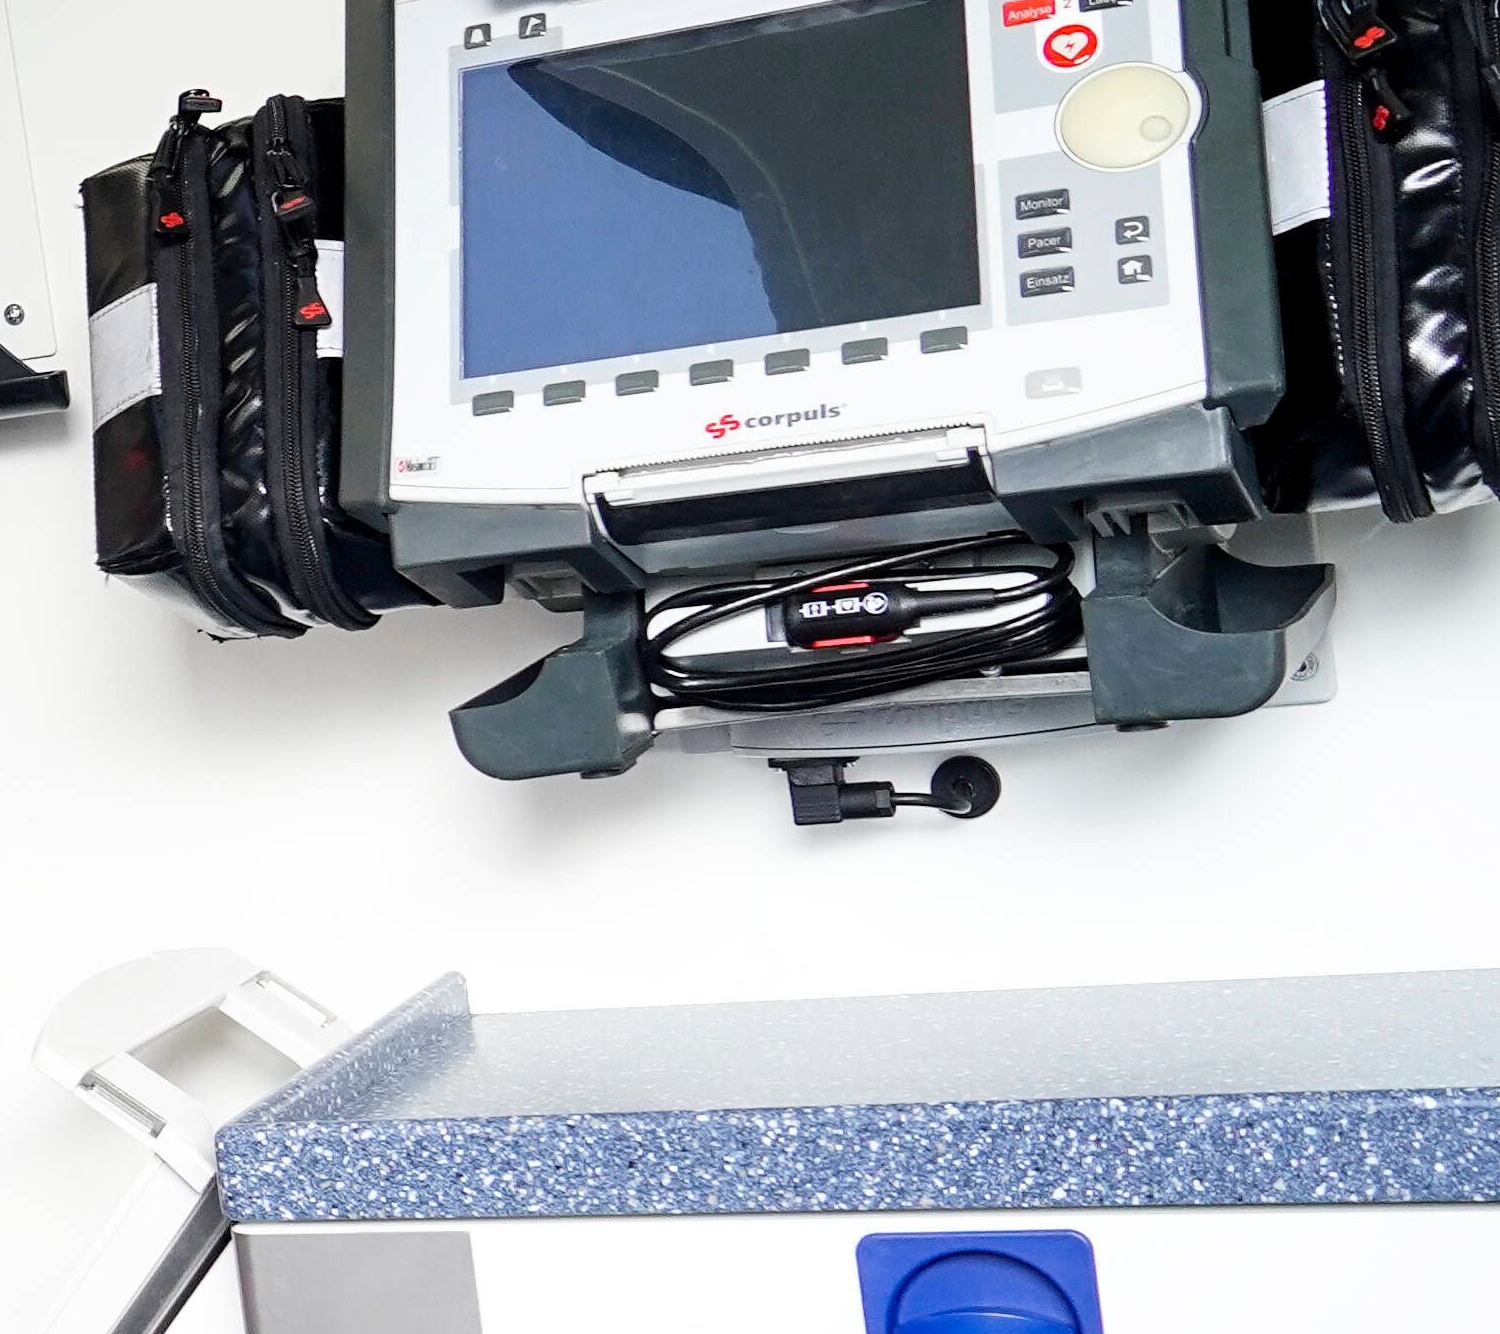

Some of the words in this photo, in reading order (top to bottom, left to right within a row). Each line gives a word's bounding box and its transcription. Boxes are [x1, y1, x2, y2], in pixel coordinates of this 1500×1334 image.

[1008, 4, 1052, 21] Analyse
[1020, 196, 1064, 211] Monitor
[1027, 235, 1061, 249] Pacer
[1026, 274, 1070, 288] Einsatz
[745, 404, 841, 427] corpuls
